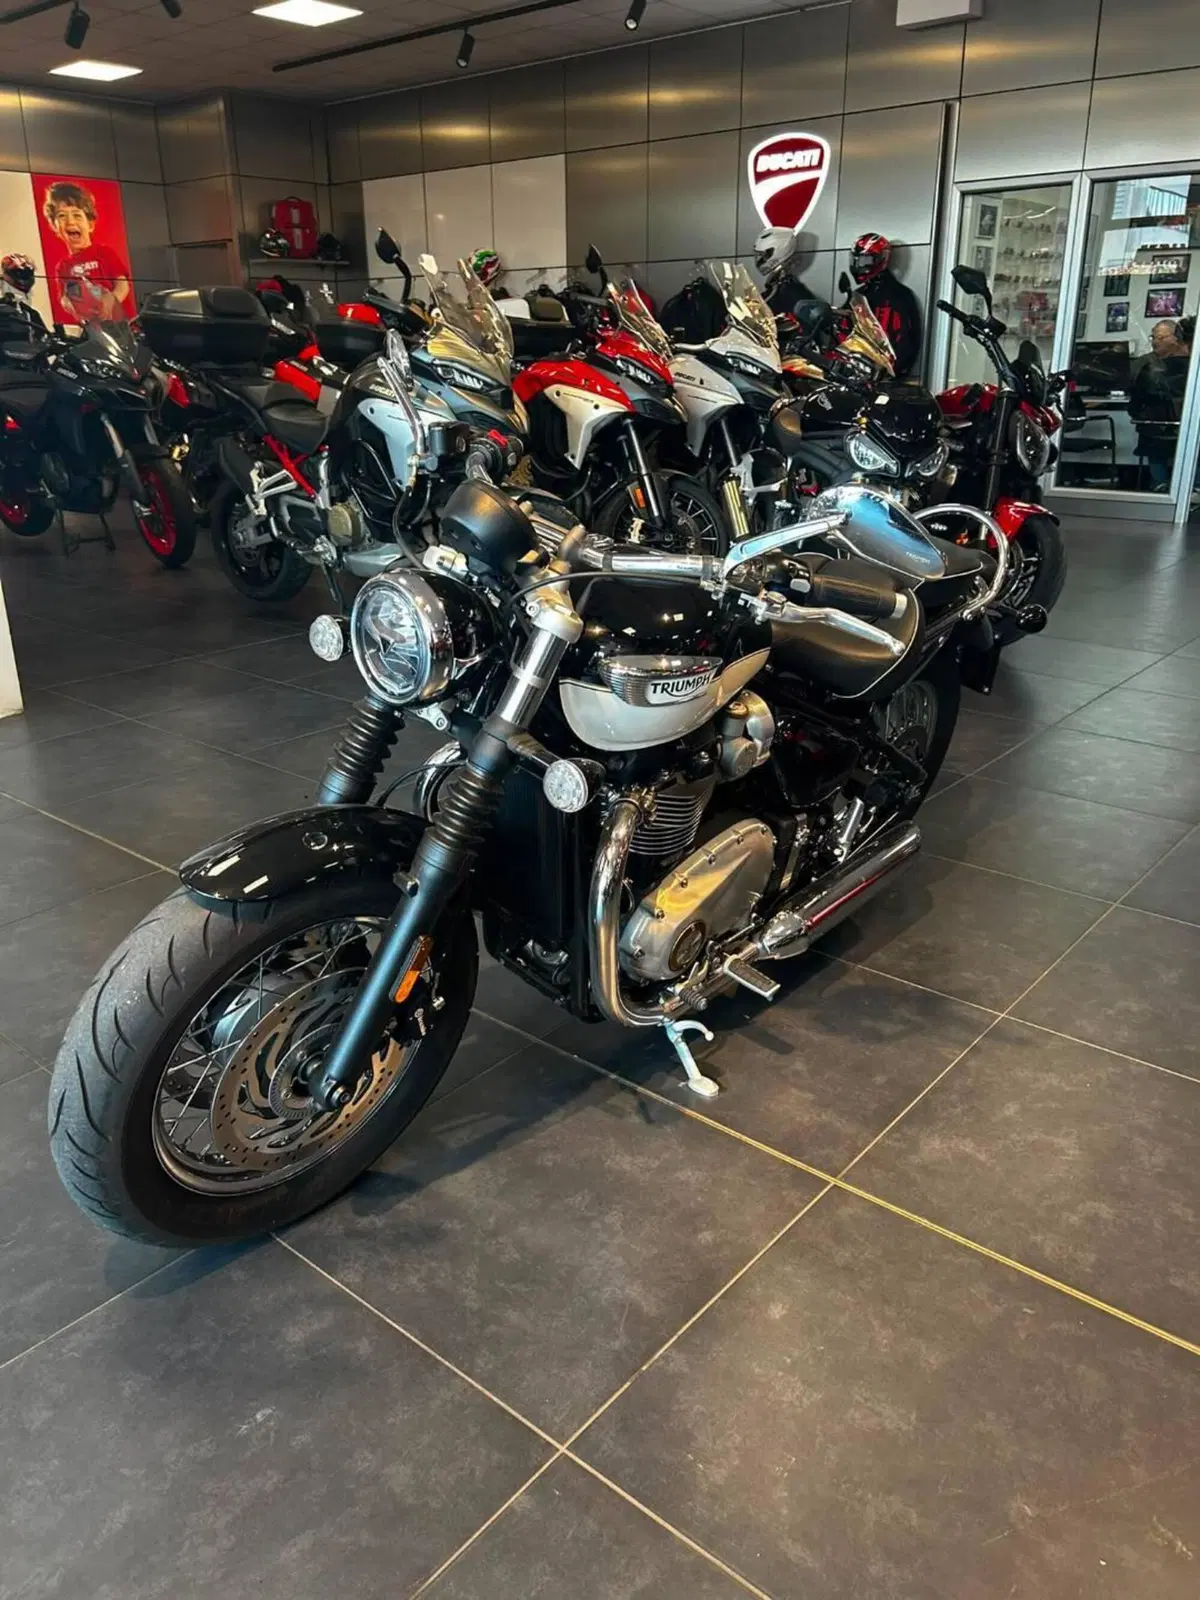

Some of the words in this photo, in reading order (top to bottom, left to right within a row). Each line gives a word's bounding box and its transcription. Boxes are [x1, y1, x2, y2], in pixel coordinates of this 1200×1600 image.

[756, 148, 821, 172] DUCATI
[71, 261, 98, 275] CATI
[651, 674, 711, 697] TRIUMPH
